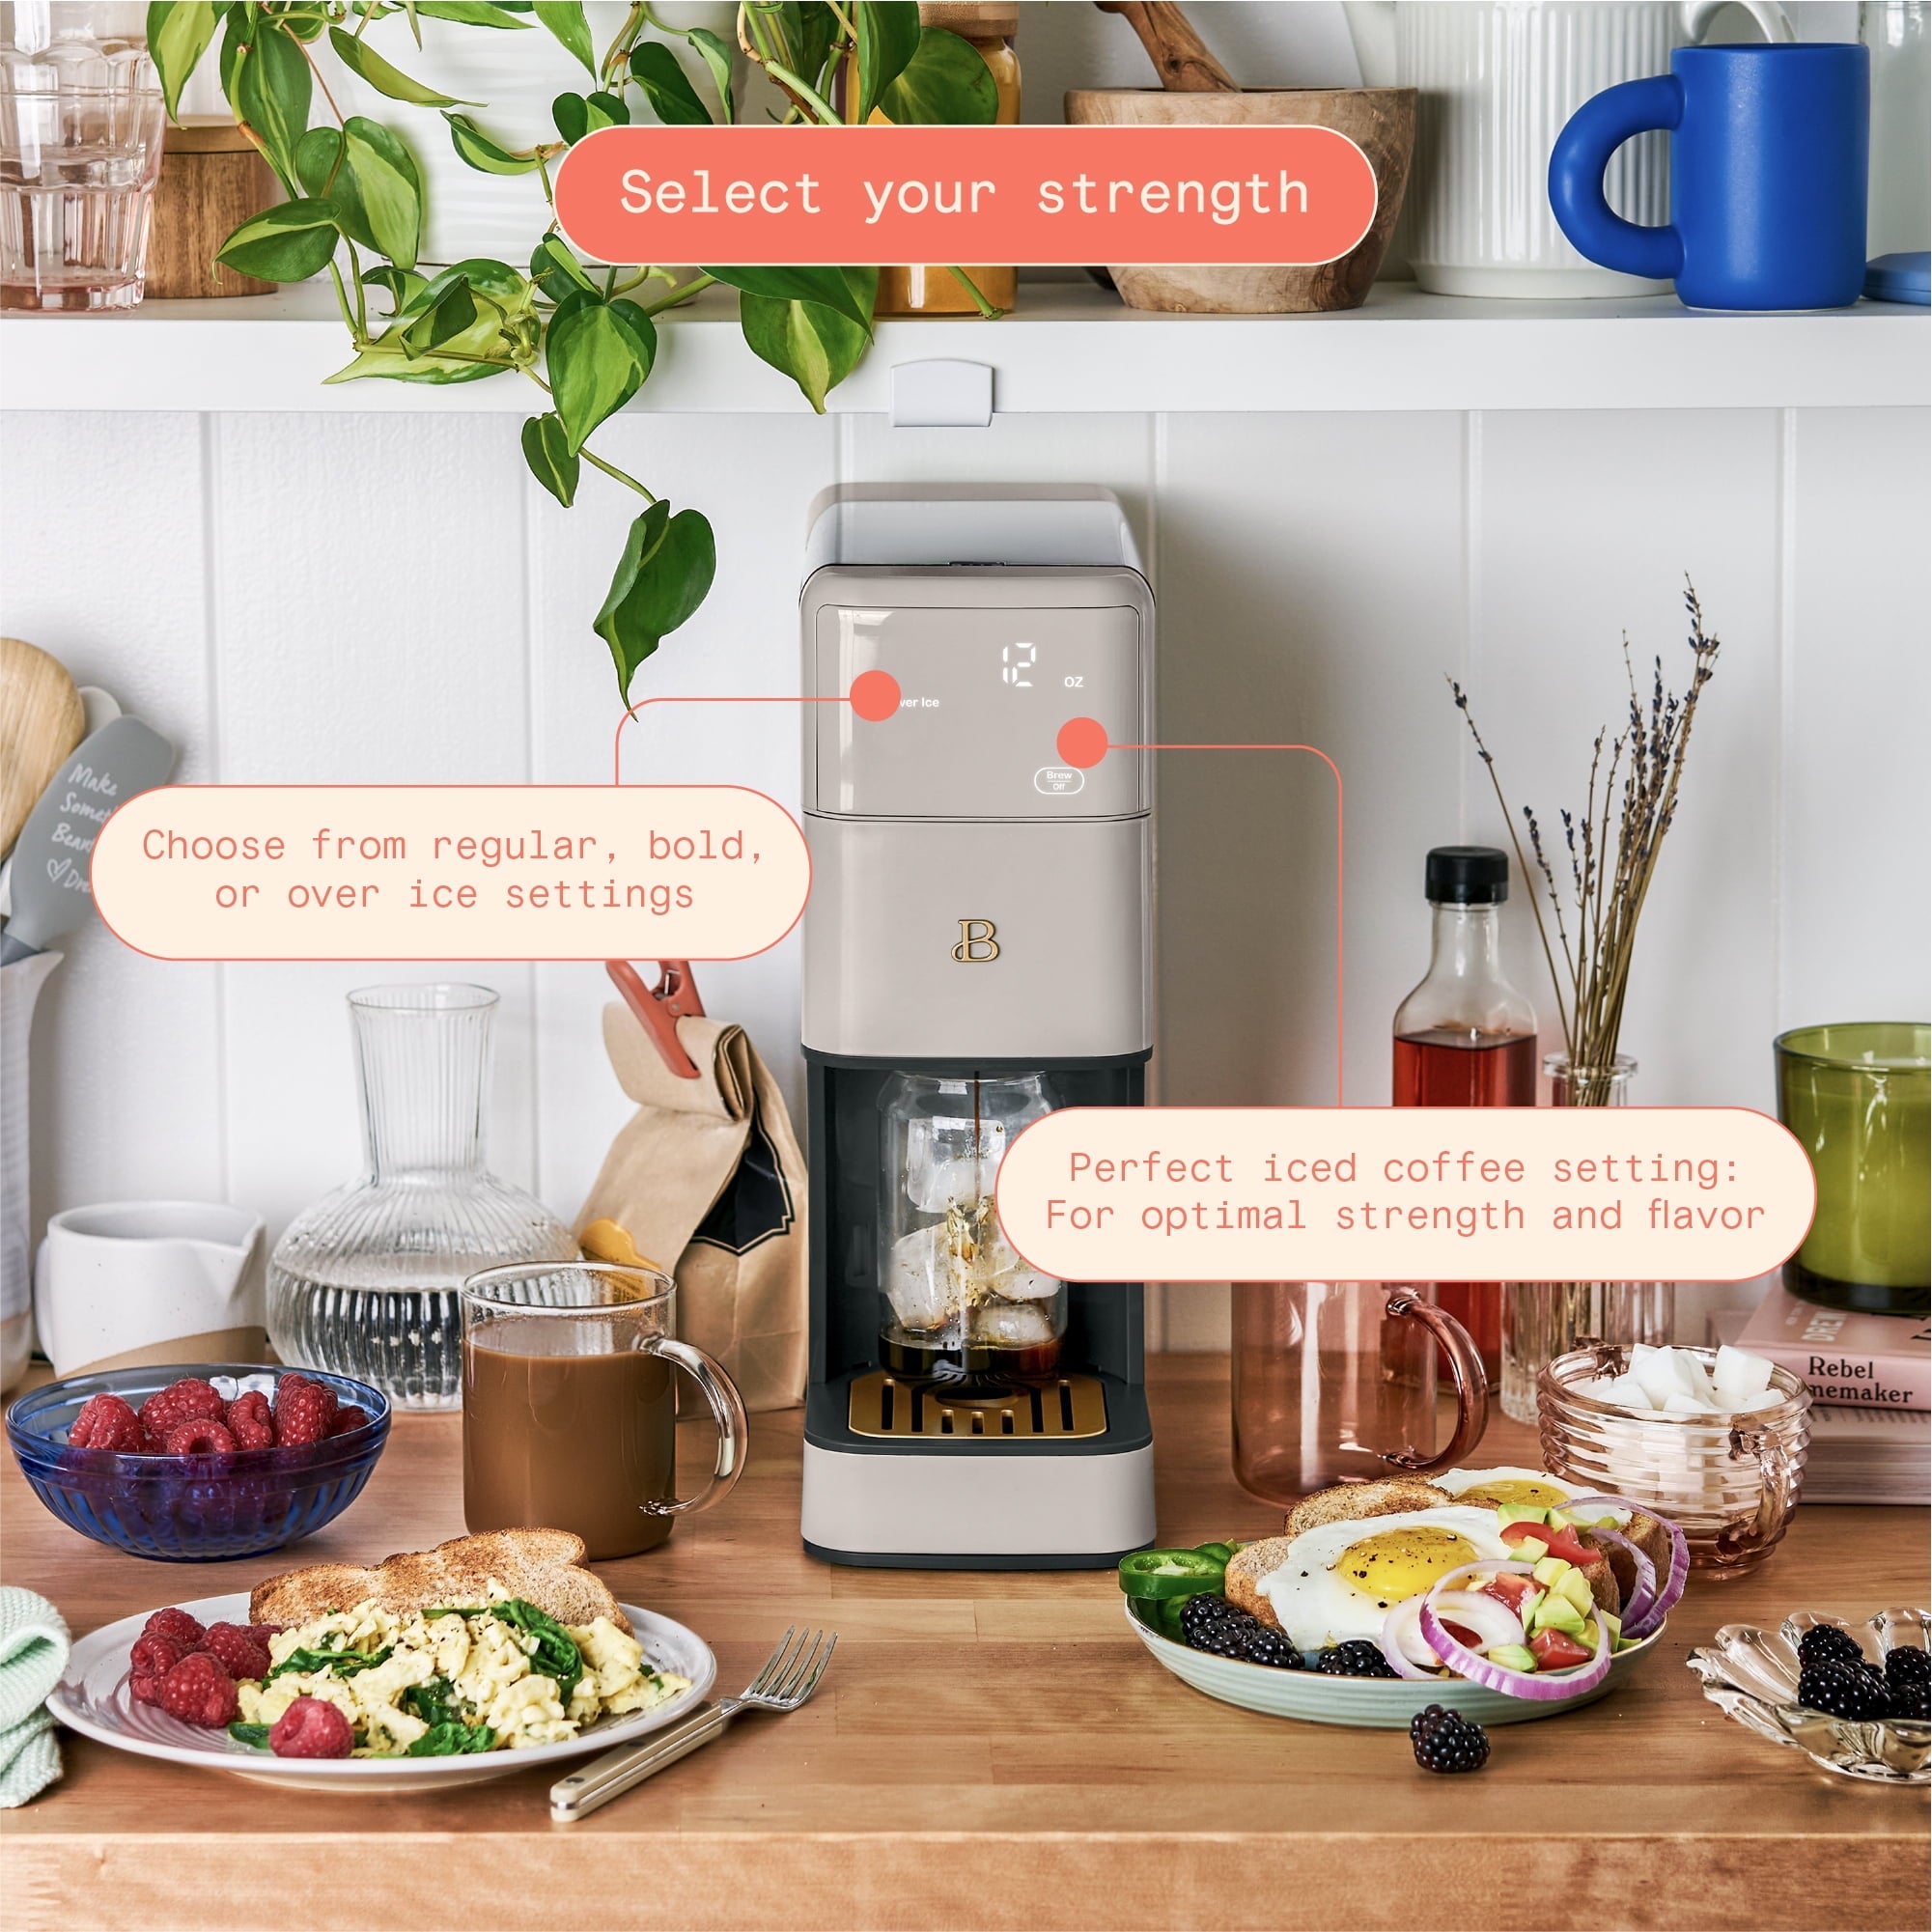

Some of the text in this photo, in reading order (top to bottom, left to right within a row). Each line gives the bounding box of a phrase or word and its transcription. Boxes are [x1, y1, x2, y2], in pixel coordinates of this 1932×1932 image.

[1002, 642, 1036, 687] 12
[899, 696, 939, 708] ver Ice
[69, 762, 118, 797] Make
[1047, 770, 1073, 780] Brew
[51, 823, 96, 853] Beau
[64, 869, 91, 893] Dre
[951, 919, 1000, 963] B
[1808, 1356, 1874, 1379] Rebel
